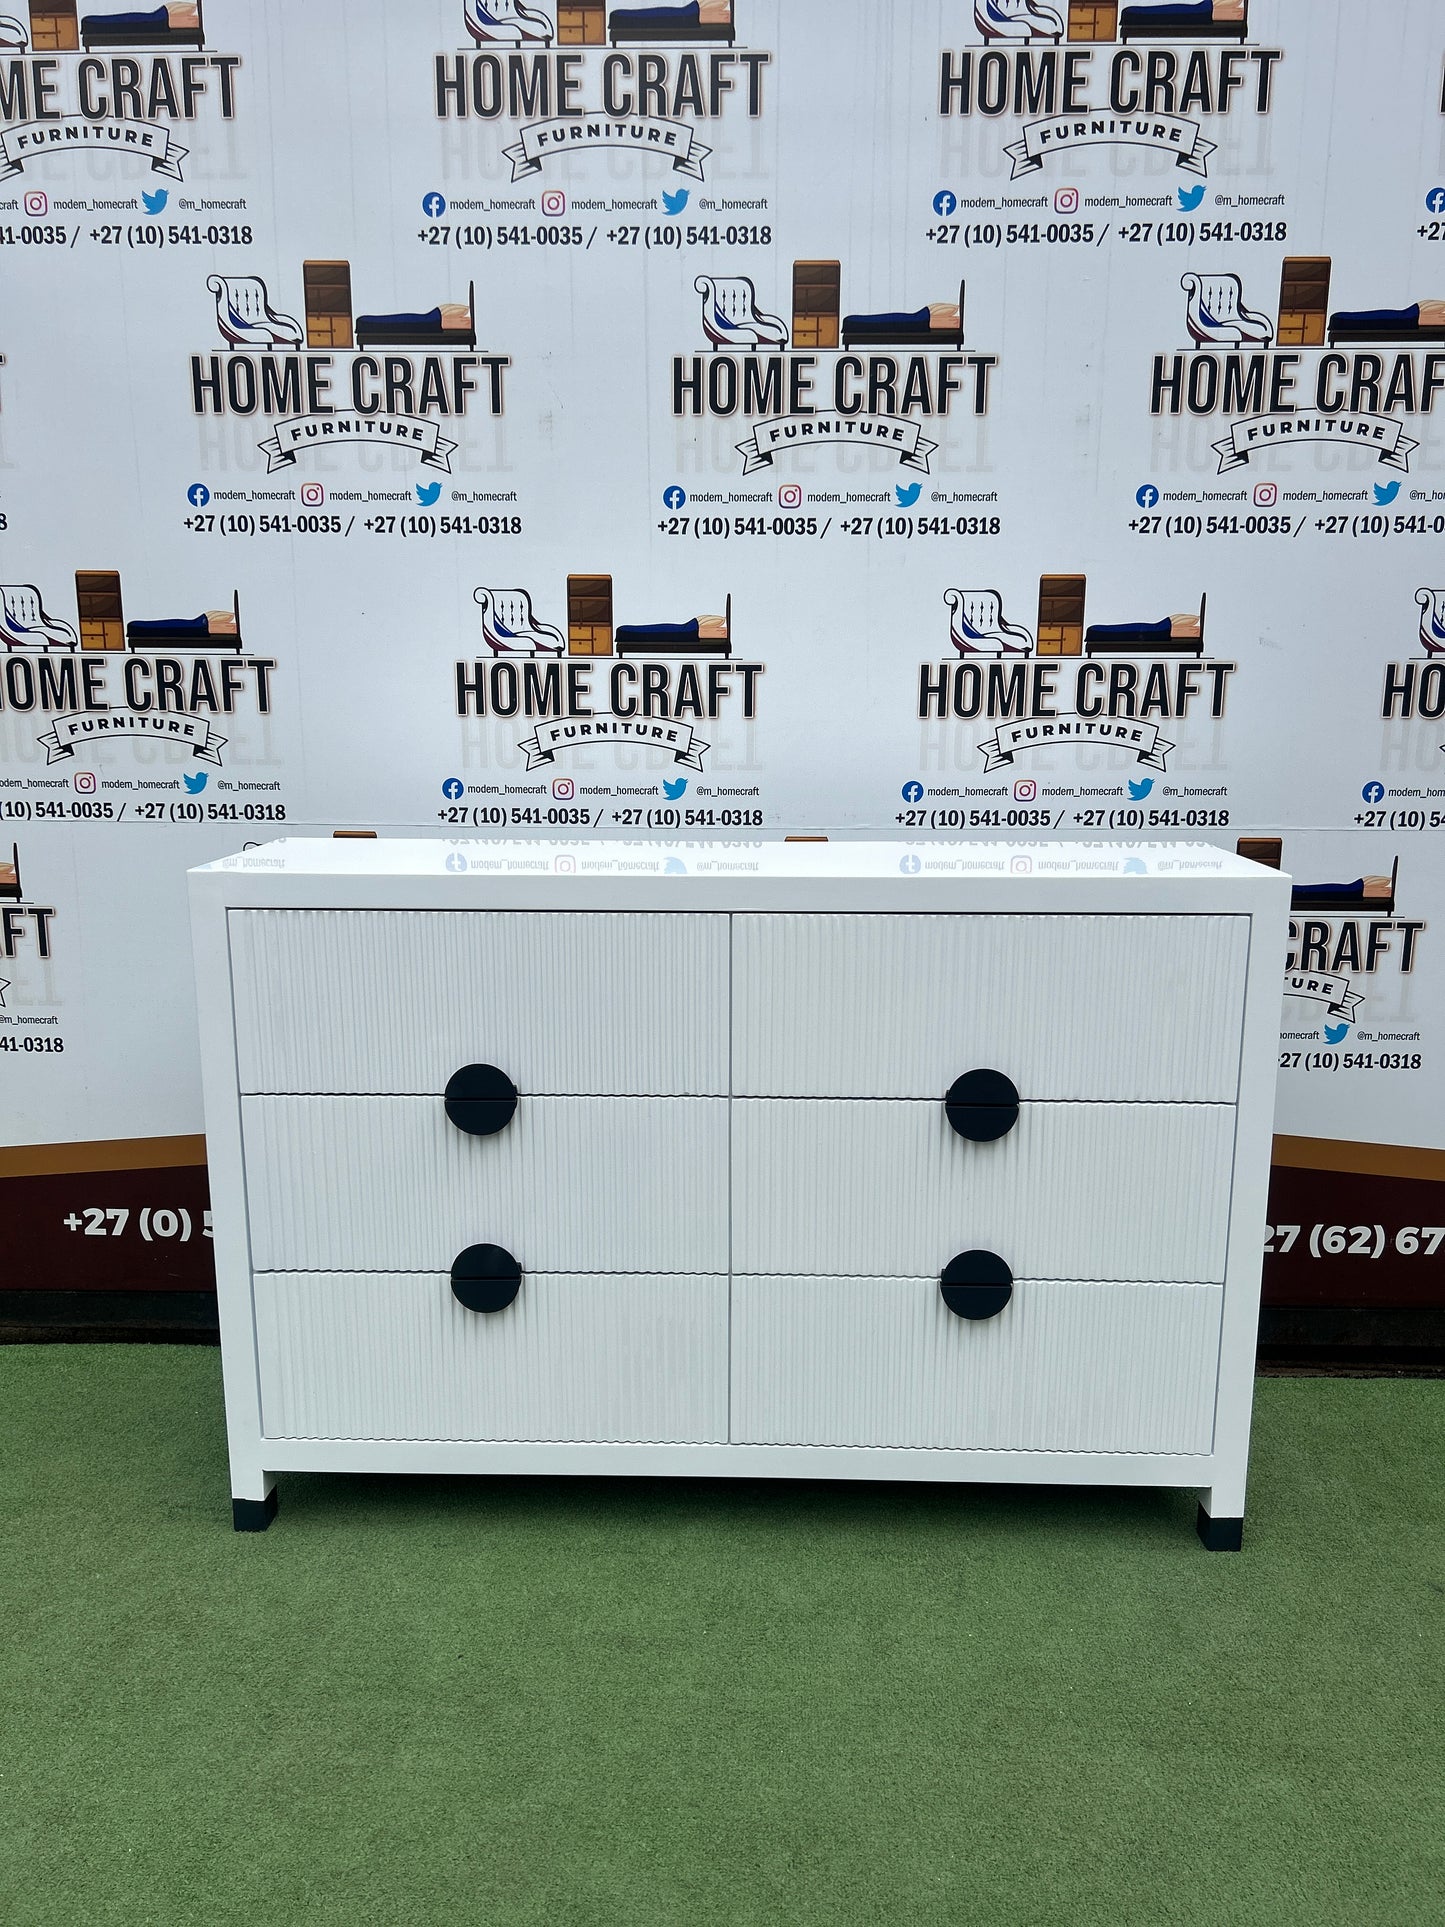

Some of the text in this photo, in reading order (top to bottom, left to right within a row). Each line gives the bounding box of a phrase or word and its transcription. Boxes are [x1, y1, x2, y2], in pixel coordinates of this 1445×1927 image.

[0, 52, 242, 120] ME CRAFT
[435, 46, 769, 118] HOME CRAFT
[940, 50, 1283, 115] HOME CRAFT
[17, 126, 153, 150] FURNITURE
[537, 123, 677, 147] FURNITURE
[1039, 120, 1182, 144] FURNITURE
[178, 198, 247, 212] @m_homecraft
[698, 198, 768, 212] @m_homecraft
[1214, 193, 1286, 208] @m_homecraft
[0, 225, 67, 245] 1-0035
[89, 225, 123, 245] +27
[127, 225, 164, 249] (10)
[168, 225, 253, 245] 541-0318
[417, 226, 451, 245] +27
[455, 226, 493, 250] (10)
[496, 225, 583, 246] 541-0035
[606, 226, 641, 245] +27
[644, 226, 682, 250] (10)
[686, 225, 772, 245] 541-0318
[925, 224, 961, 244] +27
[964, 224, 1002, 249] (10)
[1005, 223, 1094, 244] 541-0035
[1118, 222, 1153, 243] +27
[1156, 222, 1195, 247] (10)
[1199, 221, 1287, 242] 541-0318
[1416, 221, 1445, 241] +2
[191, 355, 509, 415] HOME CRAFT
[673, 356, 996, 417] HOME CRAFT
[1150, 353, 1445, 417] HOME CRAF
[290, 420, 424, 442] FURNITURE
[769, 420, 905, 443] FURNITURE
[1247, 418, 1386, 442] FURNITURE
[451, 490, 518, 504] @m_homecraft
[930, 490, 998, 504] @m_homecraft
[183, 514, 216, 532] +27
[219, 514, 256, 537] (10)
[259, 514, 342, 534] 541-0035
[363, 515, 396, 534] +27
[400, 515, 436, 538] (10)
[439, 516, 522, 535] 541-0318
[657, 517, 690, 535] +27
[694, 517, 730, 540] (10)
[734, 517, 818, 536] 541-0035
[840, 517, 874, 535] +27
[877, 517, 914, 540] (10)
[917, 516, 1001, 536] 541-0318
[1128, 516, 1162, 534] +27
[1165, 515, 1202, 538] (10)
[1205, 515, 1291, 534] 541-0035
[1314, 515, 1349, 534] +27
[1352, 515, 1390, 538] (10)
[1393, 515, 1445, 534] 541-0
[0, 656, 274, 714] OME CRAFT
[456, 661, 765, 719] HOME CRAFT
[918, 662, 1237, 720] HOME CRAFT
[1382, 663, 1445, 721] HO
[67, 716, 195, 737] FURNITURE
[549, 722, 678, 743] FURNITURE
[1011, 722, 1143, 743] FURNITURE
[217, 779, 281, 792] @m_homecraft
[696, 785, 760, 798] @m_homecraft
[1162, 785, 1228, 798] @m_homecraft
[35, 801, 114, 819] 541-0035
[134, 802, 166, 819] +27
[169, 802, 204, 824] (10)
[207, 803, 286, 821] 541-0318
[437, 806, 469, 823] +27
[472, 807, 507, 828] (10)
[510, 807, 591, 825] 541-0035
[611, 808, 643, 825] +27
[646, 808, 681, 829] (10)
[684, 809, 763, 826] 541-0318
[895, 809, 927, 827] +27
[930, 809, 966, 830] (10)
[969, 809, 1051, 827] 541-0035
[1072, 809, 1106, 826] +27
[1108, 809, 1145, 830] (10)
[1147, 809, 1230, 827] 541-0318
[1353, 810, 1387, 827] +27
[1389, 810, 1426, 832] (10)
[0, 1036, 64, 1053] 41-0318
[1356, 1030, 1421, 1043] @m_homecraft
[1279, 1052, 1422, 1072] 27 (10) 541-0318
[64, 1208, 129, 1235] +27
[140, 1208, 191, 1241] (0)
[1310, 1224, 1385, 1258] (62)
[1396, 1227, 1445, 1254] 67
